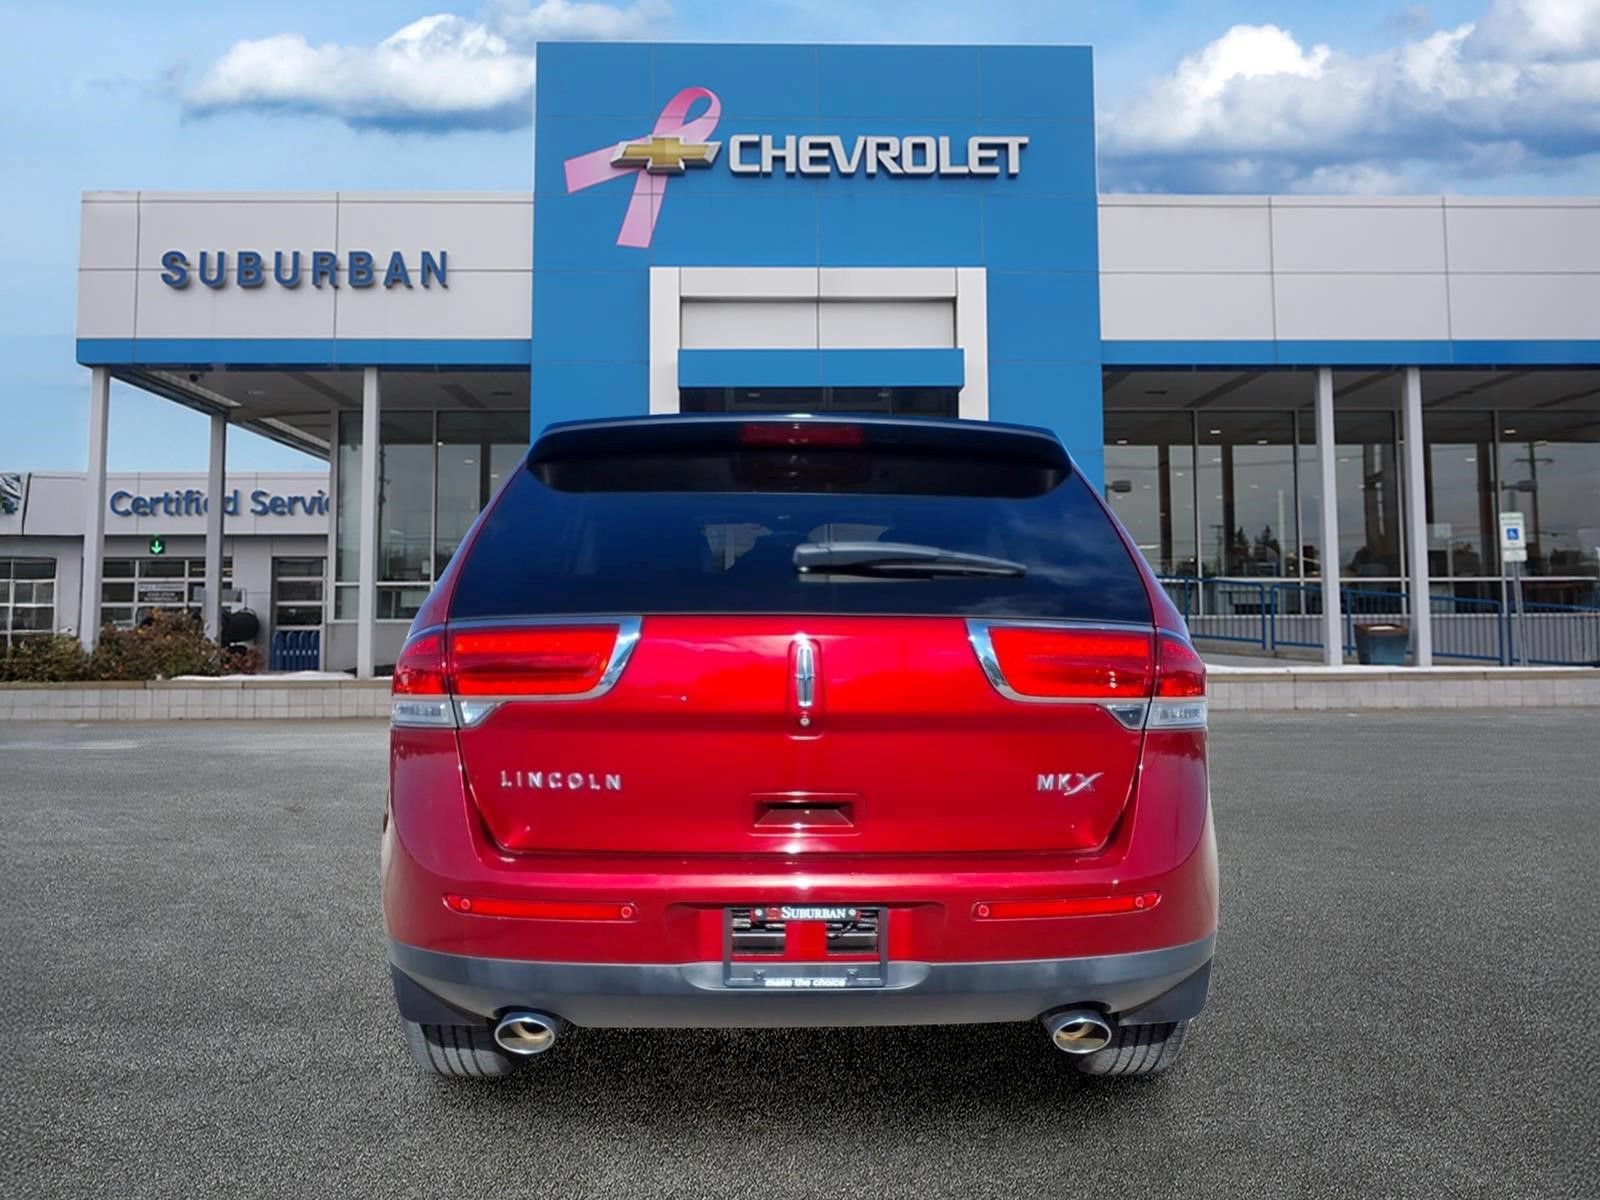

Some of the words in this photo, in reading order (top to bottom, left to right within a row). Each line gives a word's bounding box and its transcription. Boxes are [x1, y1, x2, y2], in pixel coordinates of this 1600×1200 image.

[729, 134, 1029, 175] CHEVROLET
[161, 250, 449, 290] SUBURBAN
[501, 770, 621, 790] LINCOLN
[1037, 772, 1104, 796] MKX
